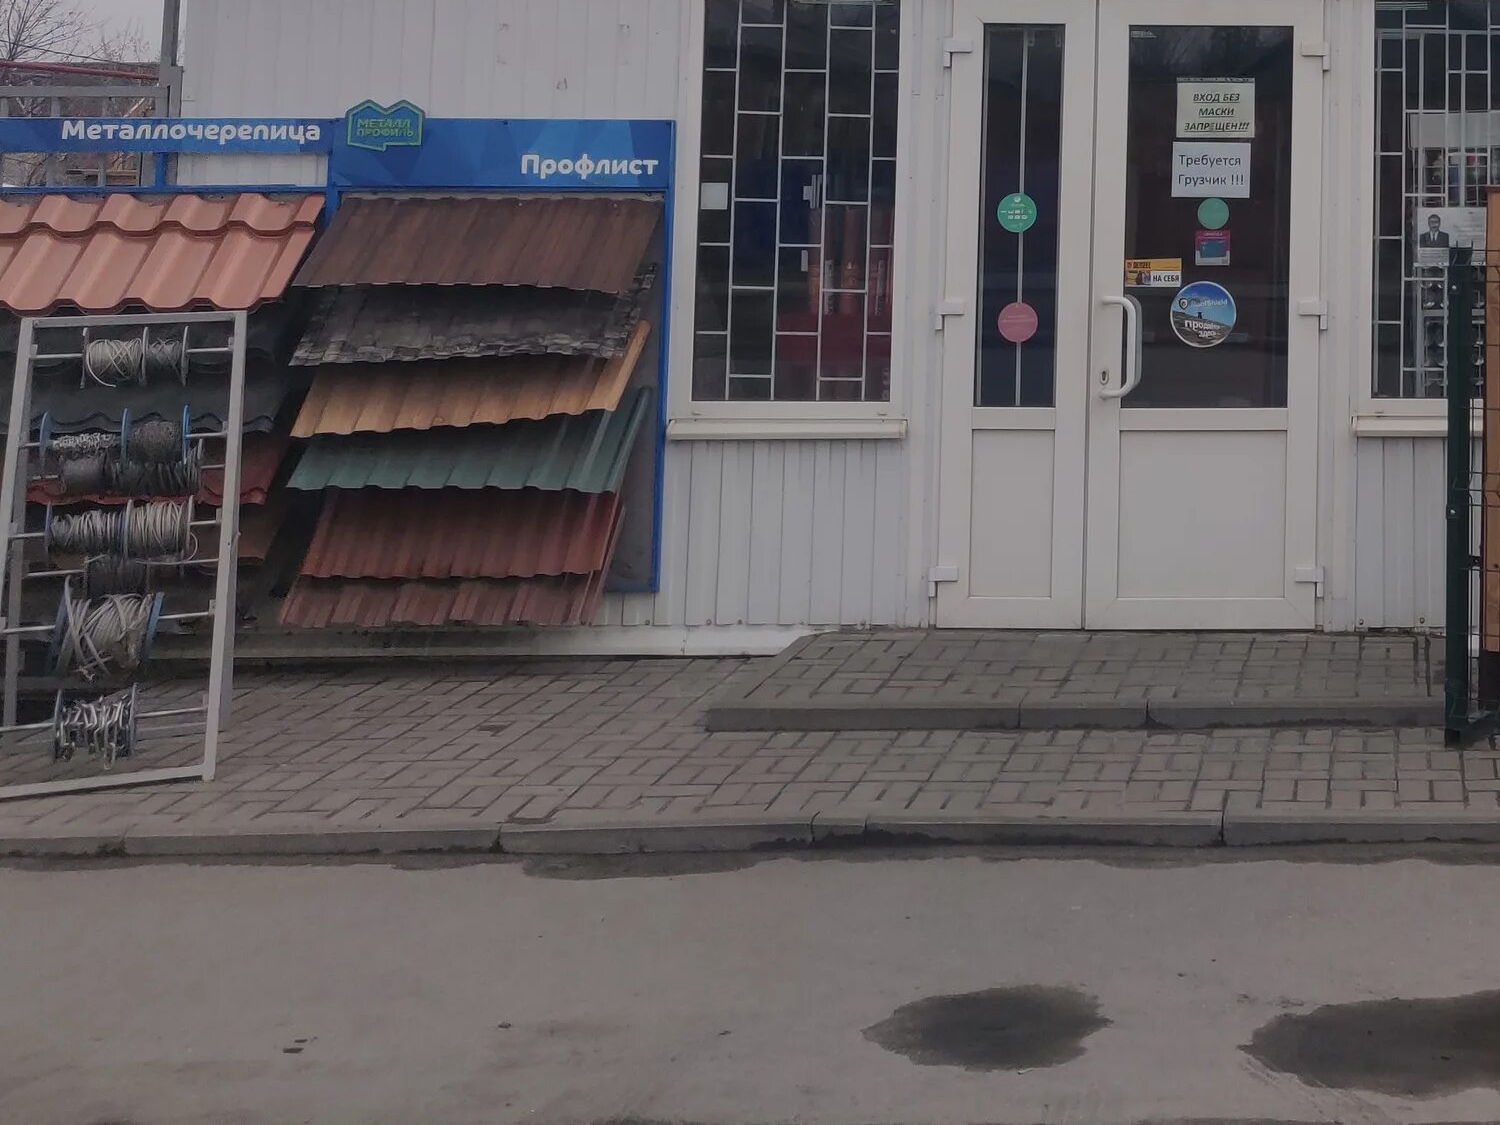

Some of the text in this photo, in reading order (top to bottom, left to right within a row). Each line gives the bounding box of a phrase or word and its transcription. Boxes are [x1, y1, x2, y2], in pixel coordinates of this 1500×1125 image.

[1193, 93, 1240, 103] ВХОД БЕЗ
[1199, 107, 1235, 116] МАСКИ
[61, 120, 321, 145] Металлочерепица
[521, 153, 659, 180] Профлист
[1179, 155, 1241, 167] Требуется
[1178, 174, 1226, 187] Грузчик
